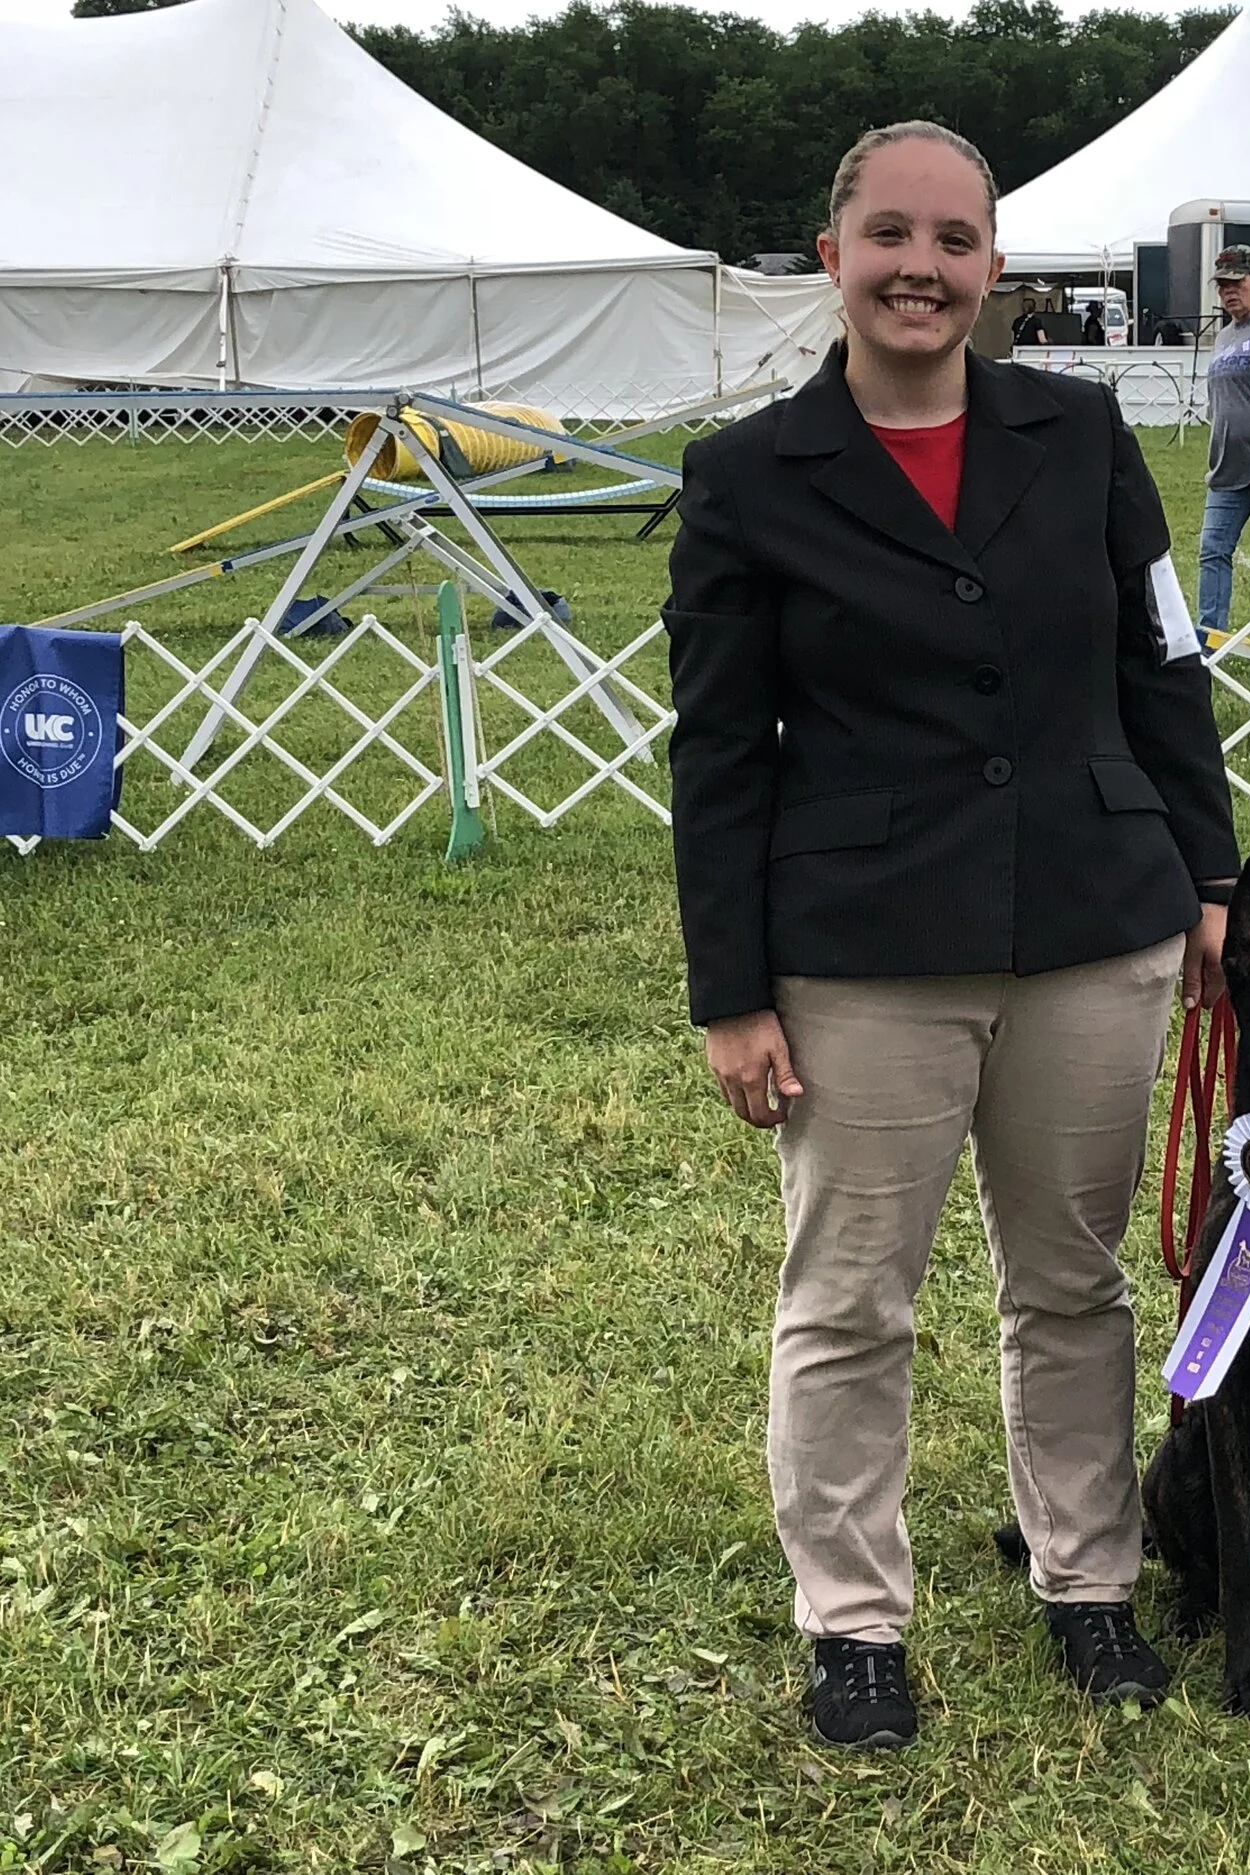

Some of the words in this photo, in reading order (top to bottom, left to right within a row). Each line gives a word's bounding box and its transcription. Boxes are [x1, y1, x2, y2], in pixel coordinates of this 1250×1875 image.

[41, 678, 57, 689] TO
[59, 682, 92, 716] WHOM
[24, 713, 75, 742] UKC
[47, 773, 59, 783] IS
